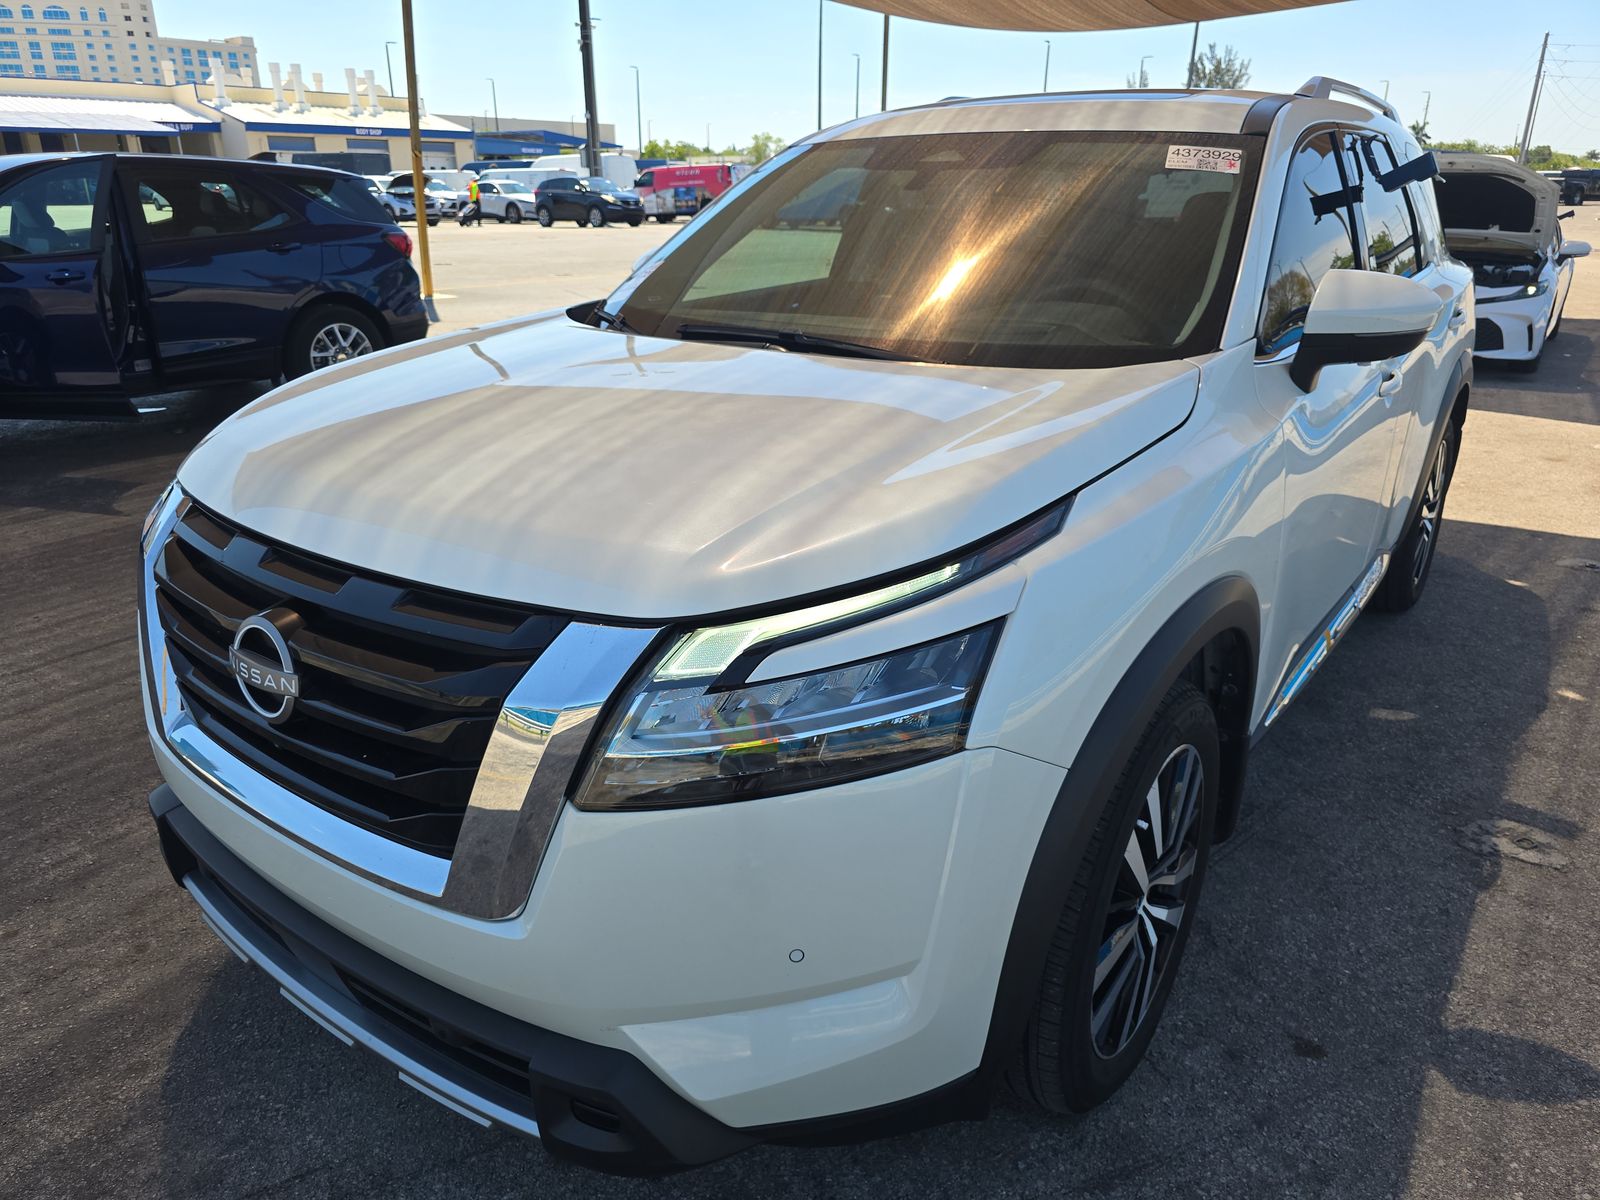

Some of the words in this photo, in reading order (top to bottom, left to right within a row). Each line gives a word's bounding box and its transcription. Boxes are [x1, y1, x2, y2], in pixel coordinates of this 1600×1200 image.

[180, 123, 193, 131] BUFF
[369, 128, 382, 136] SHOP
[1171, 148, 1242, 162] 4373929
[229, 650, 296, 694] NISSAN
